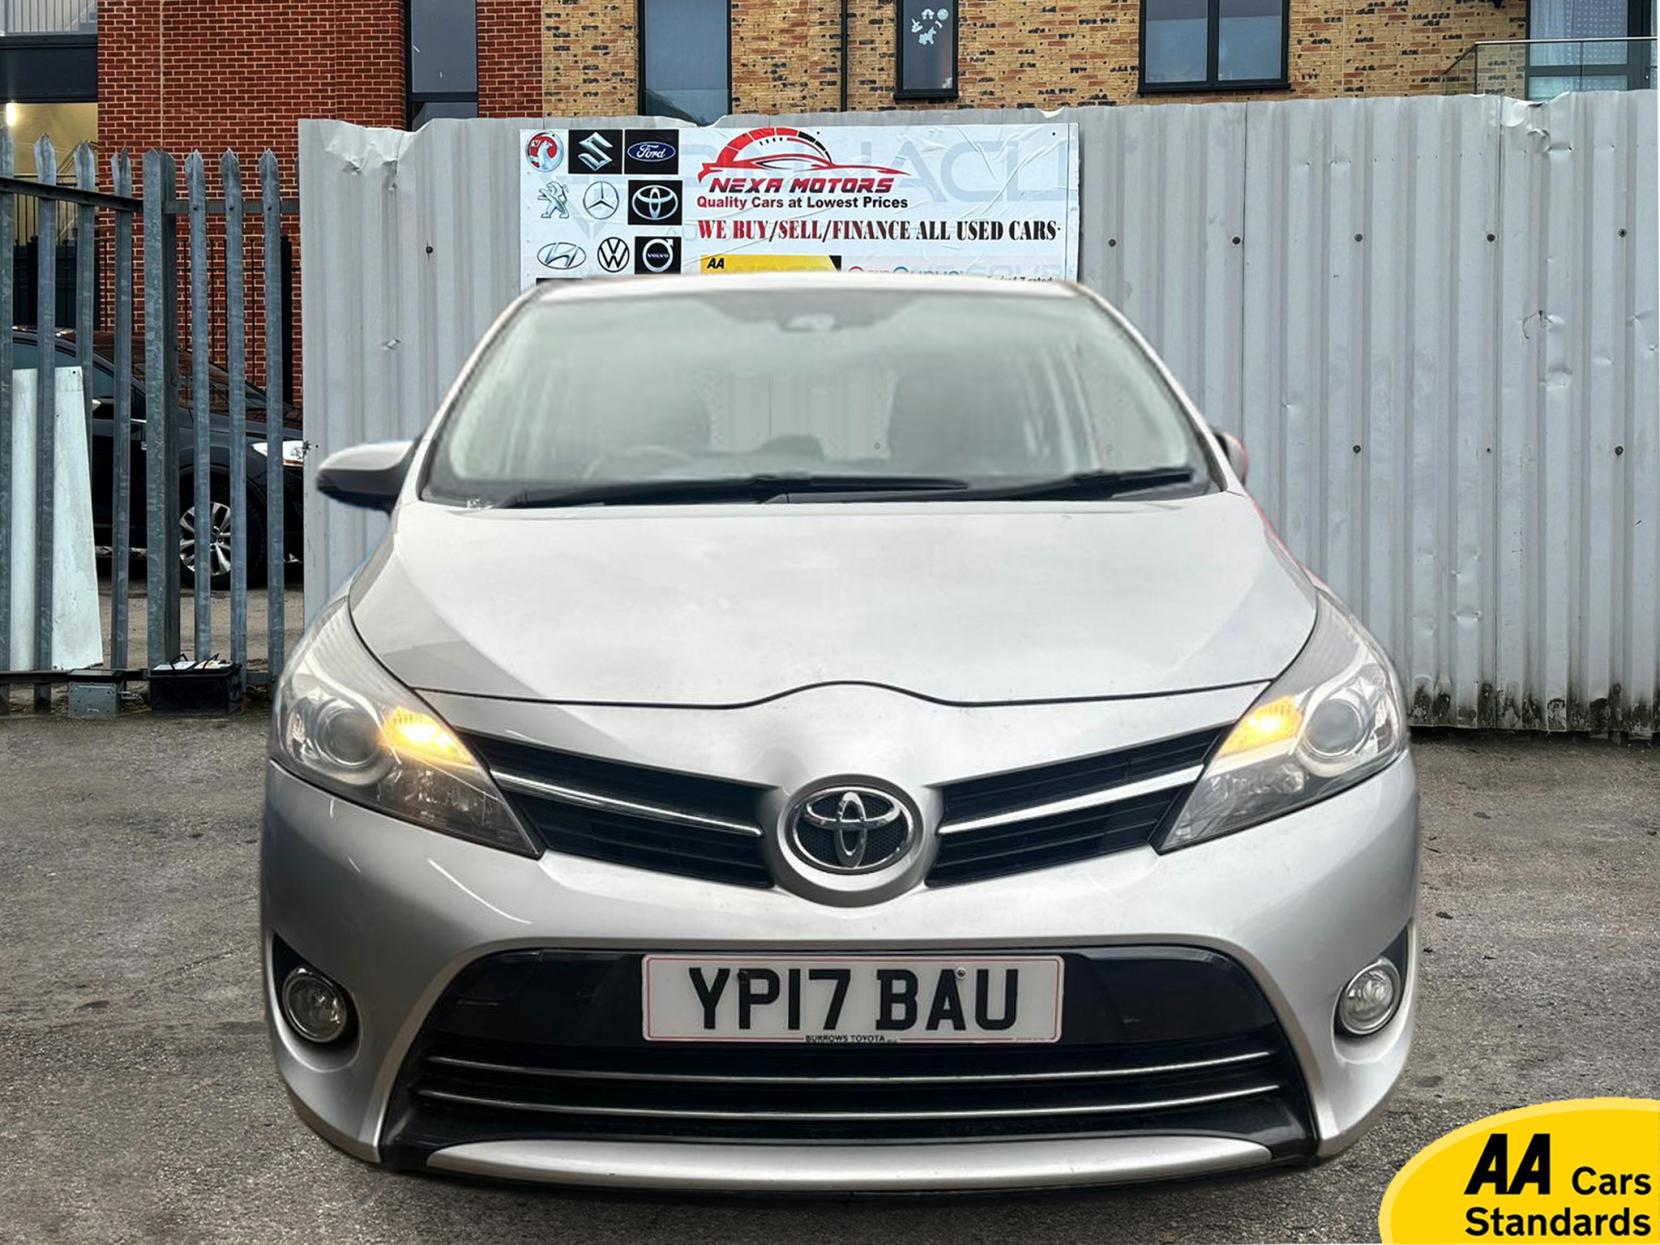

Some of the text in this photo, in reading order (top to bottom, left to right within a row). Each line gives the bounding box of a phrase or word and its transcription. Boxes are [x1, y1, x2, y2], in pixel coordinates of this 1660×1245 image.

[636, 144, 668, 159] Ford
[708, 177, 895, 193] NEXA MOTORS
[697, 196, 908, 210] Quality Cars at Lowest Prices
[697, 219, 727, 240] WE
[916, 220, 951, 241] ALL
[956, 220, 1004, 241] USED
[1009, 220, 1057, 241] CARS
[706, 257, 725, 269] AA
[688, 967, 1019, 1031] YP17 BAU
[805, 1034, 848, 1043] BURROWS
[851, 1034, 886, 1043] TOYOTA
